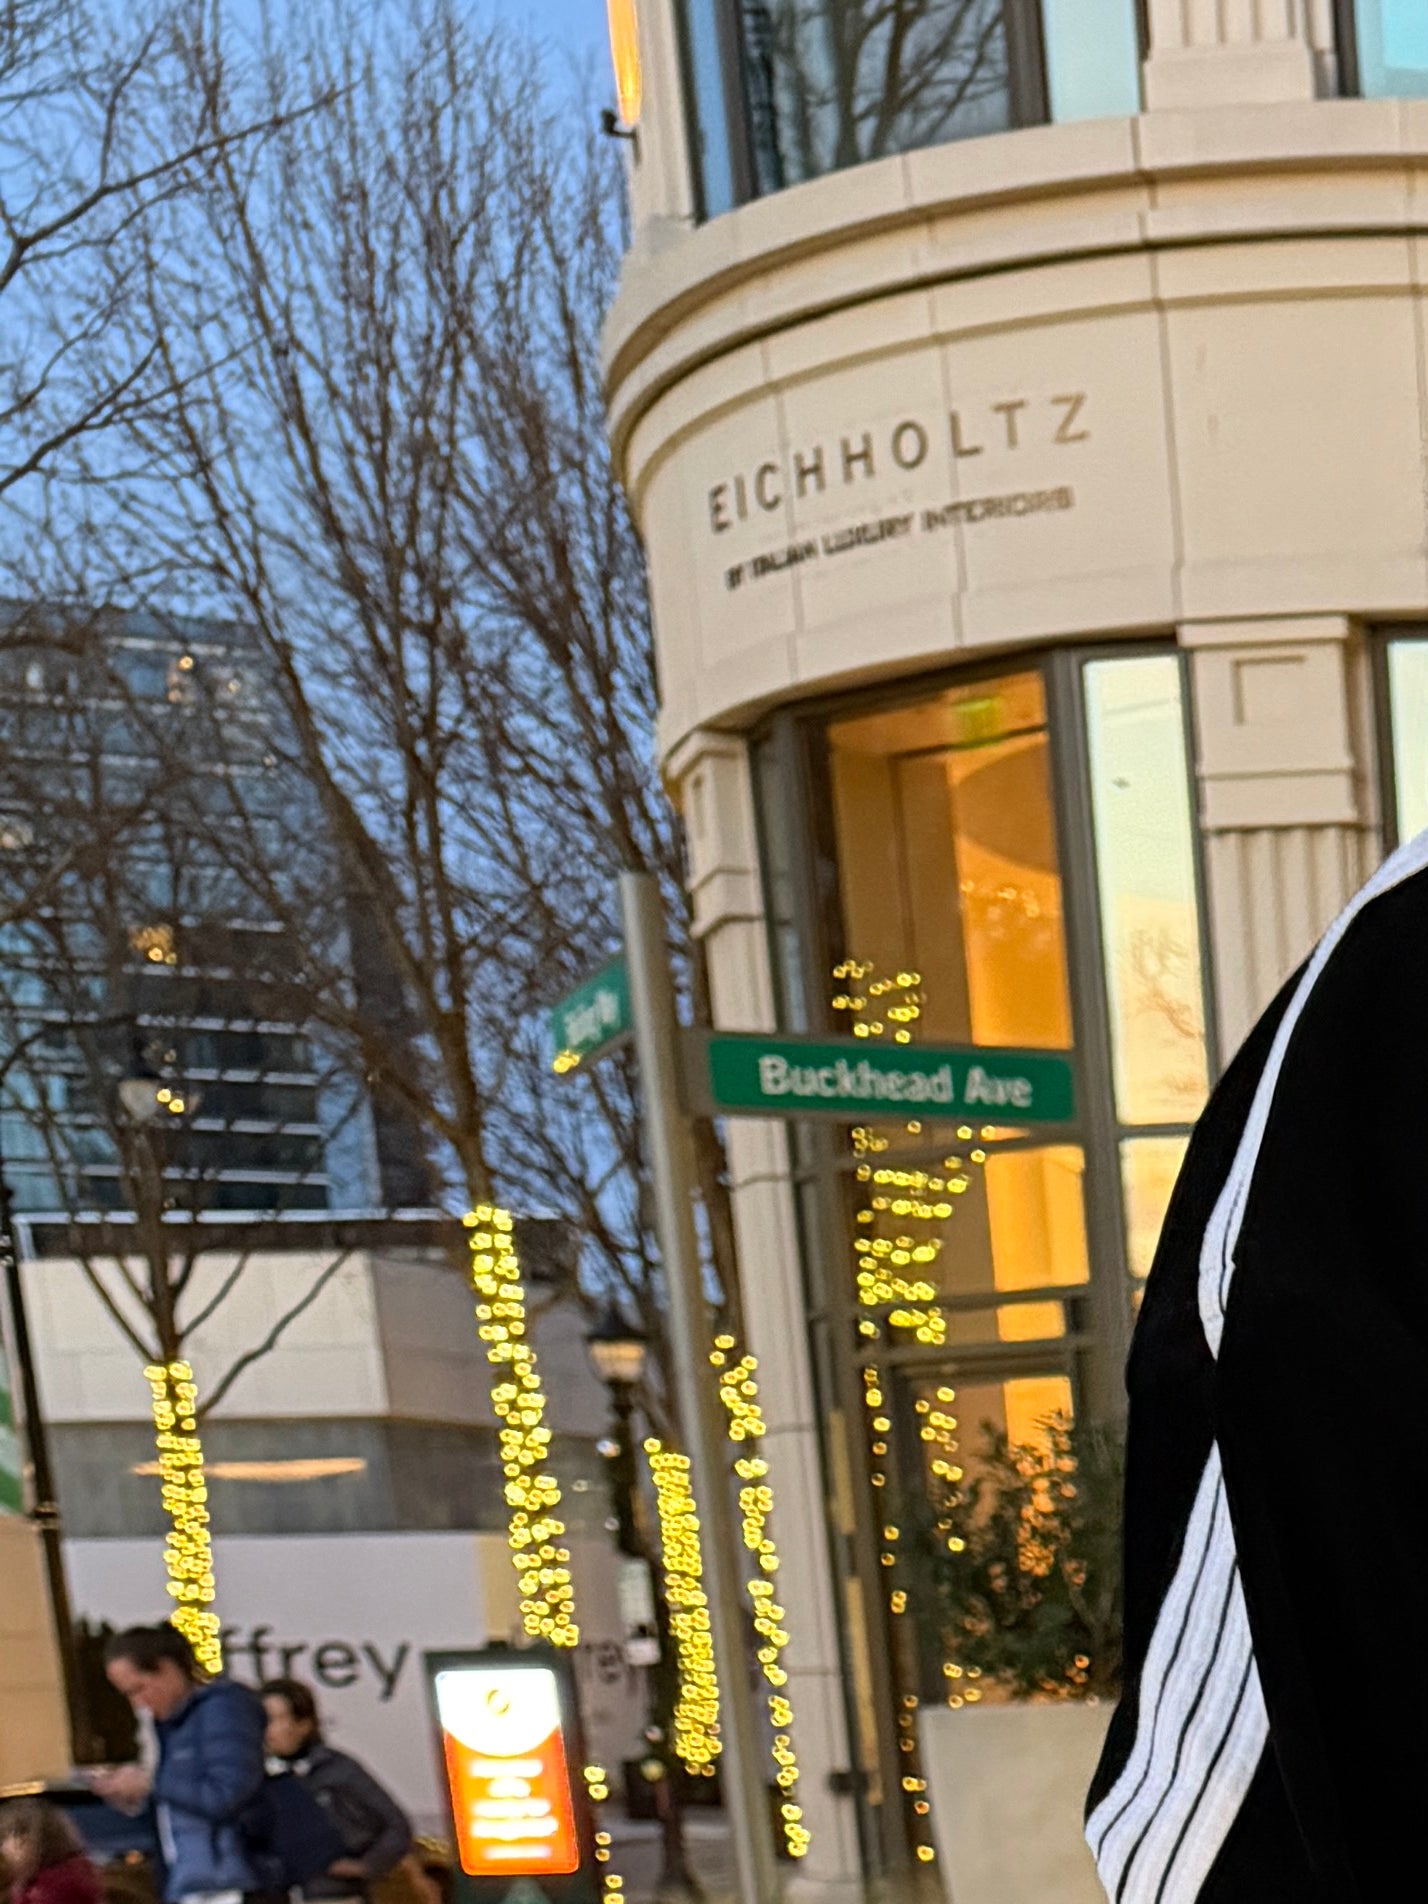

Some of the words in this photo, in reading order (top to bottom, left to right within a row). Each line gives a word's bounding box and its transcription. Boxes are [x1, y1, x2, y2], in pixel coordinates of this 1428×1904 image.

[707, 391, 1092, 534] EICHHOLTZ
[757, 1054, 954, 1104] Buckhead
[963, 1064, 1033, 1108] Ave
